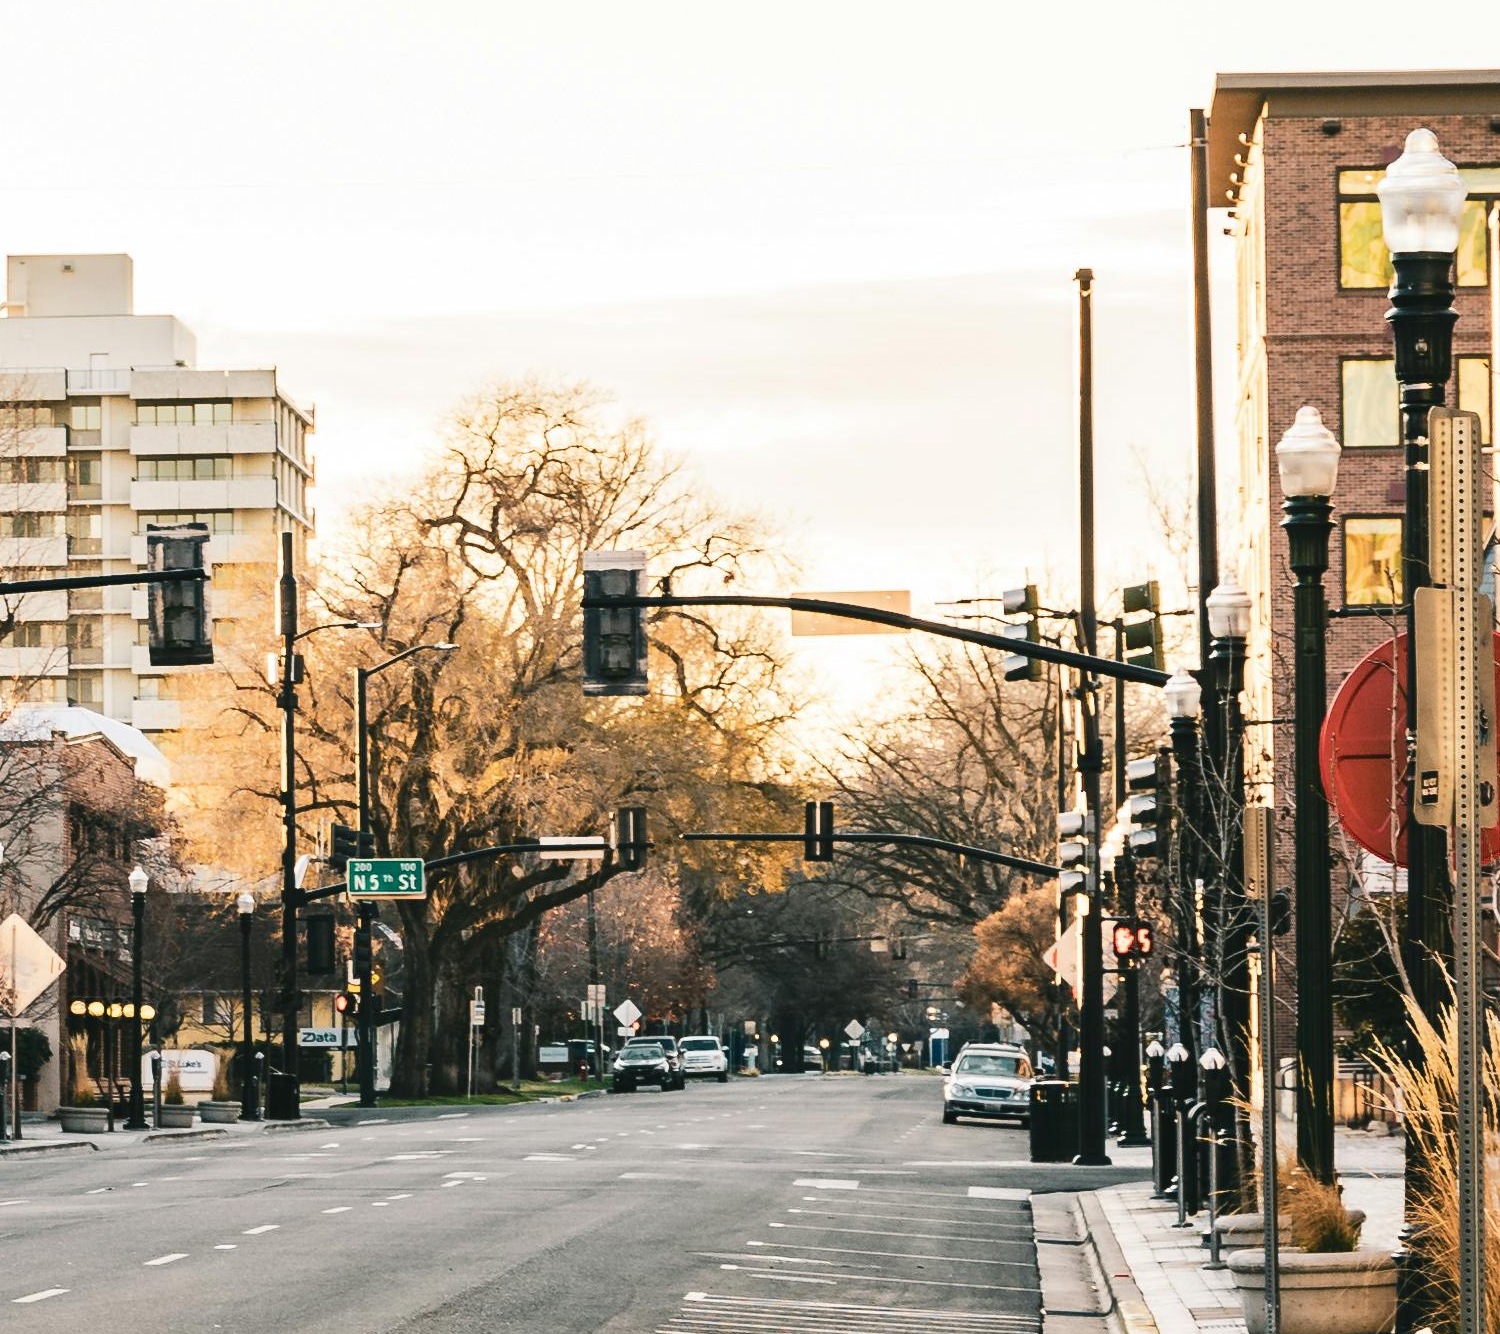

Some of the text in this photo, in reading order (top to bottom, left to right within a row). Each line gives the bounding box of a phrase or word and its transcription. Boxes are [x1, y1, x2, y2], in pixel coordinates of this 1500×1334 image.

[354, 862, 417, 872] 200 100
[354, 874, 366, 890] N
[398, 873, 417, 890] St
[1137, 928, 1151, 953] 5
